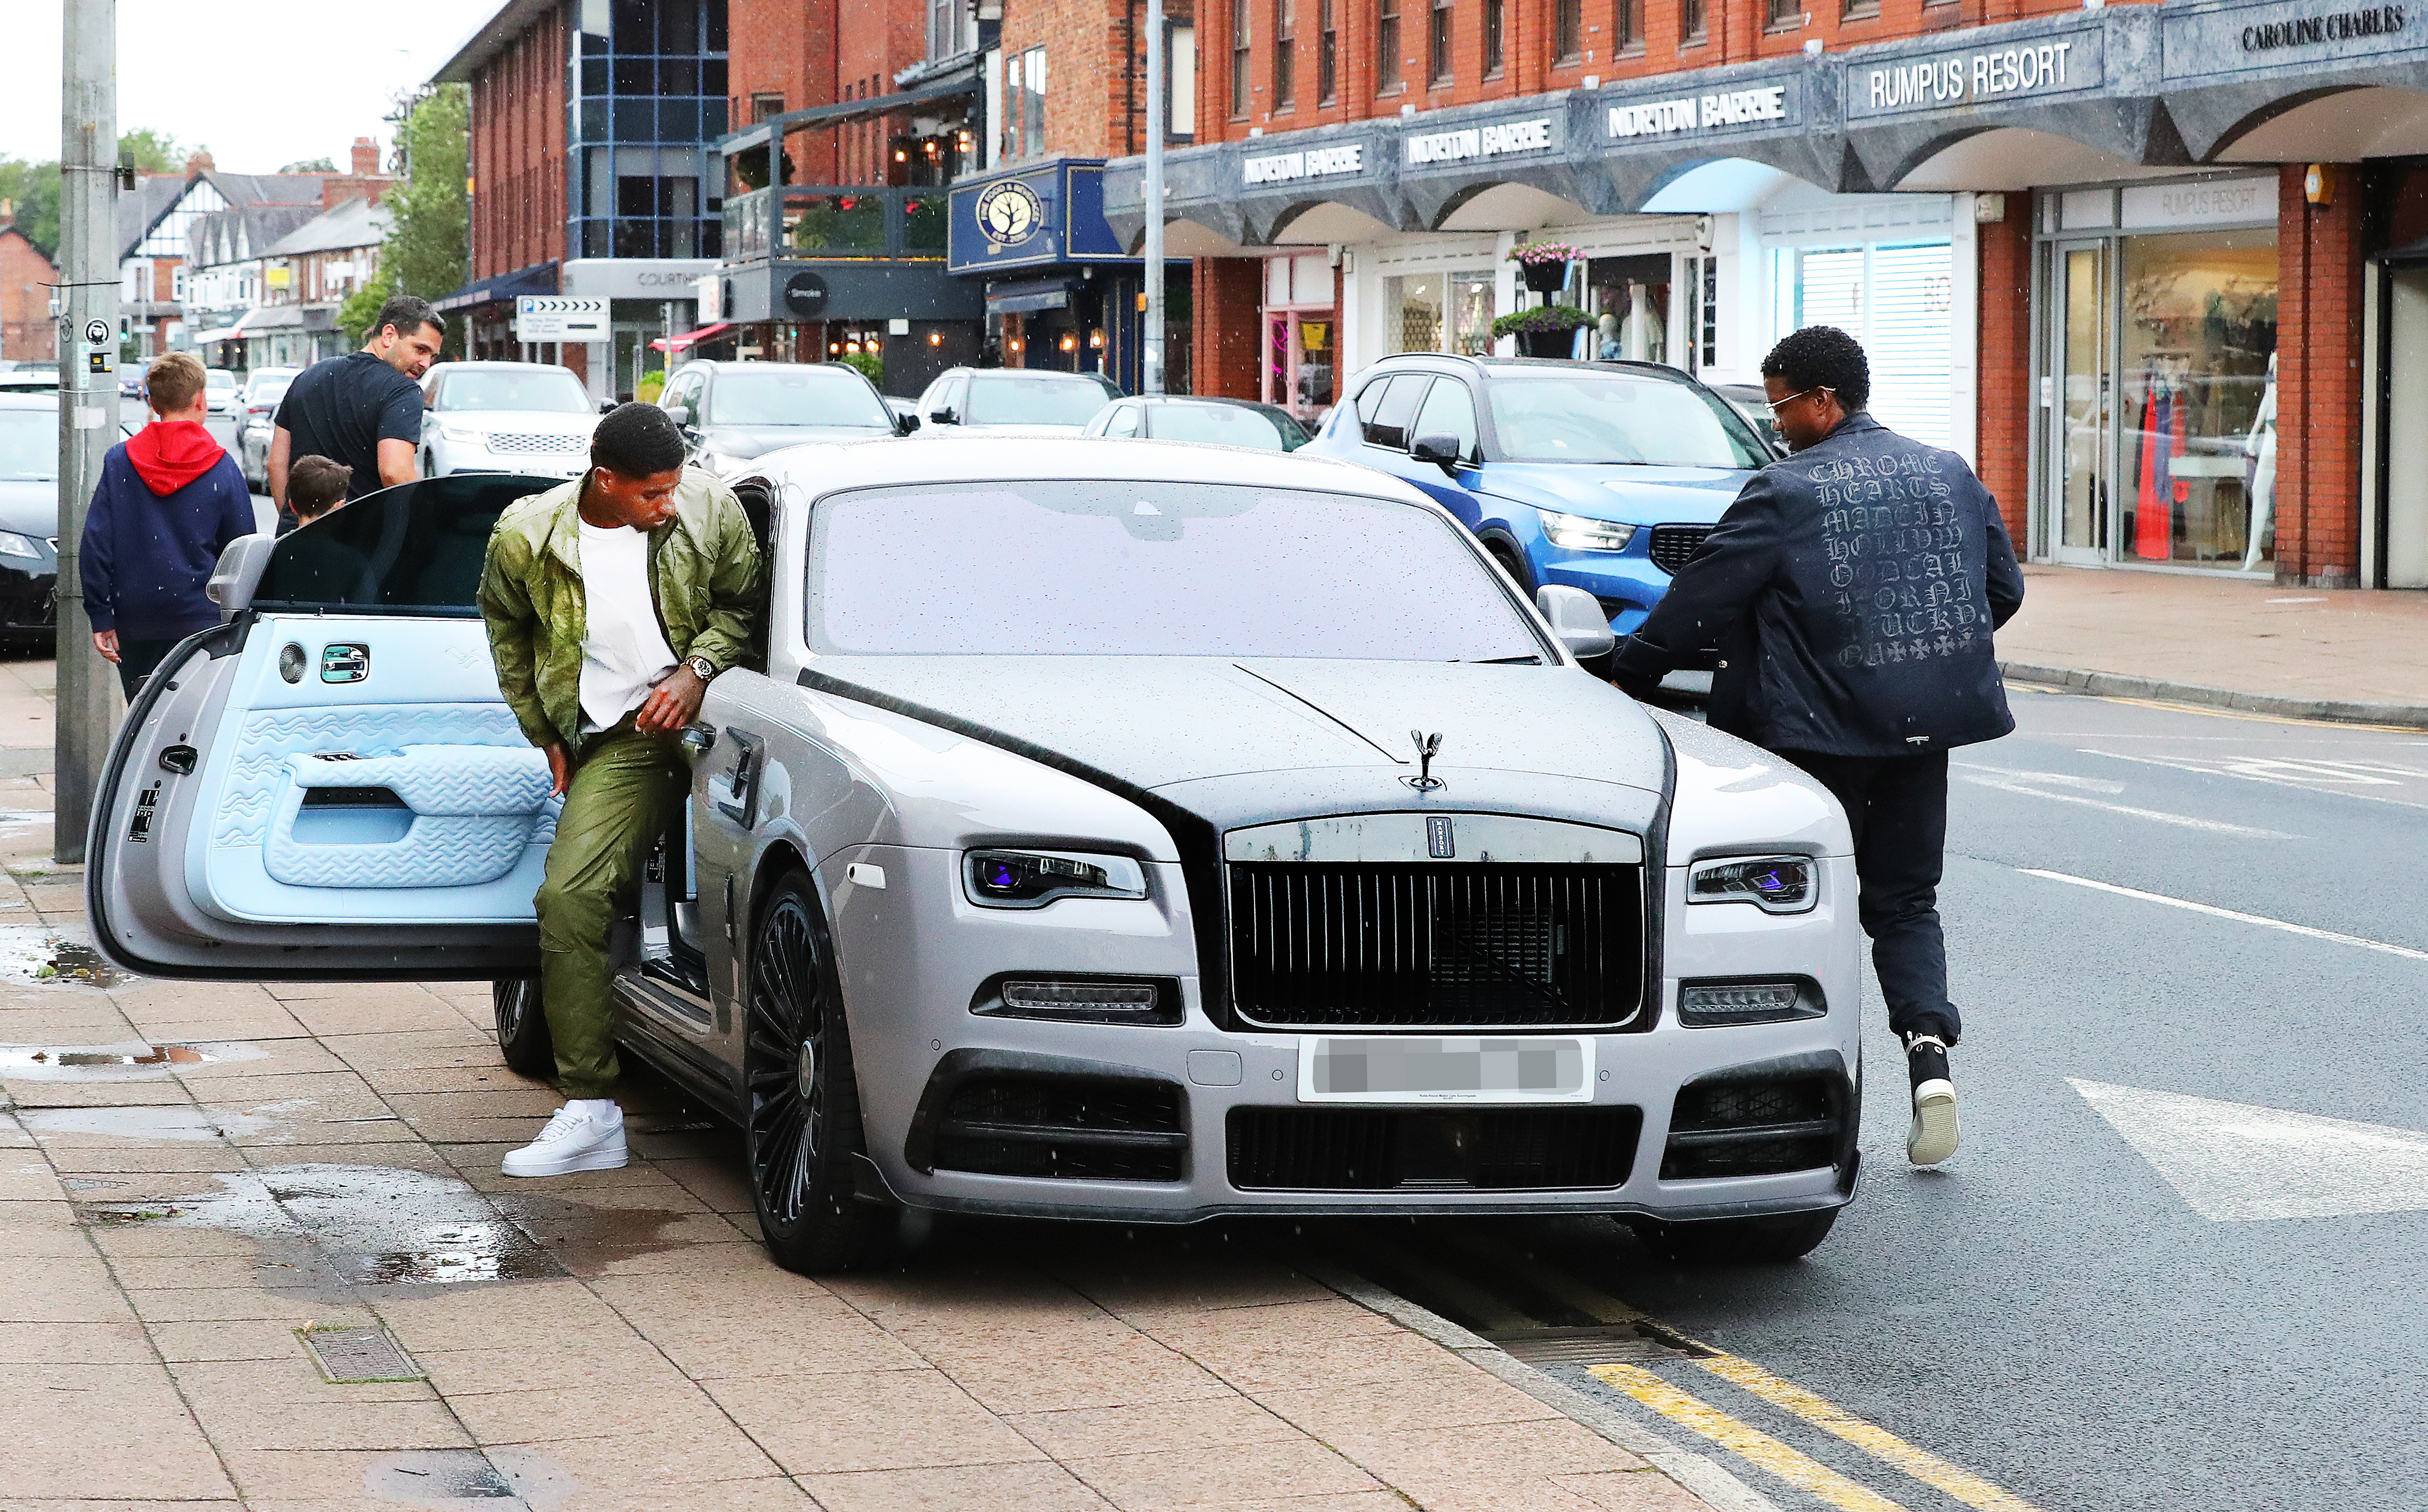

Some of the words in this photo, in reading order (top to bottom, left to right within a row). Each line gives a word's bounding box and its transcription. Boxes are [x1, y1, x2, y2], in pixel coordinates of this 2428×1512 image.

[2243, 16, 2325, 51] CAROLINE
[2326, 4, 2404, 40] CHARLES
[1870, 58, 1964, 109] RUMPUS
[1972, 42, 2071, 95] RESORT
[1609, 97, 1697, 138] NORTON
[1701, 85, 1786, 127] BARRIE
[1408, 128, 1480, 163] NORTON
[1482, 118, 1551, 155] BARRIE
[1244, 152, 1305, 183] NORTON
[1306, 144, 1363, 177] BARRIE
[1808, 452, 1943, 484] CHROME
[1814, 476, 1951, 507] HEARTS
[1436, 820, 1445, 855] MANSORY
